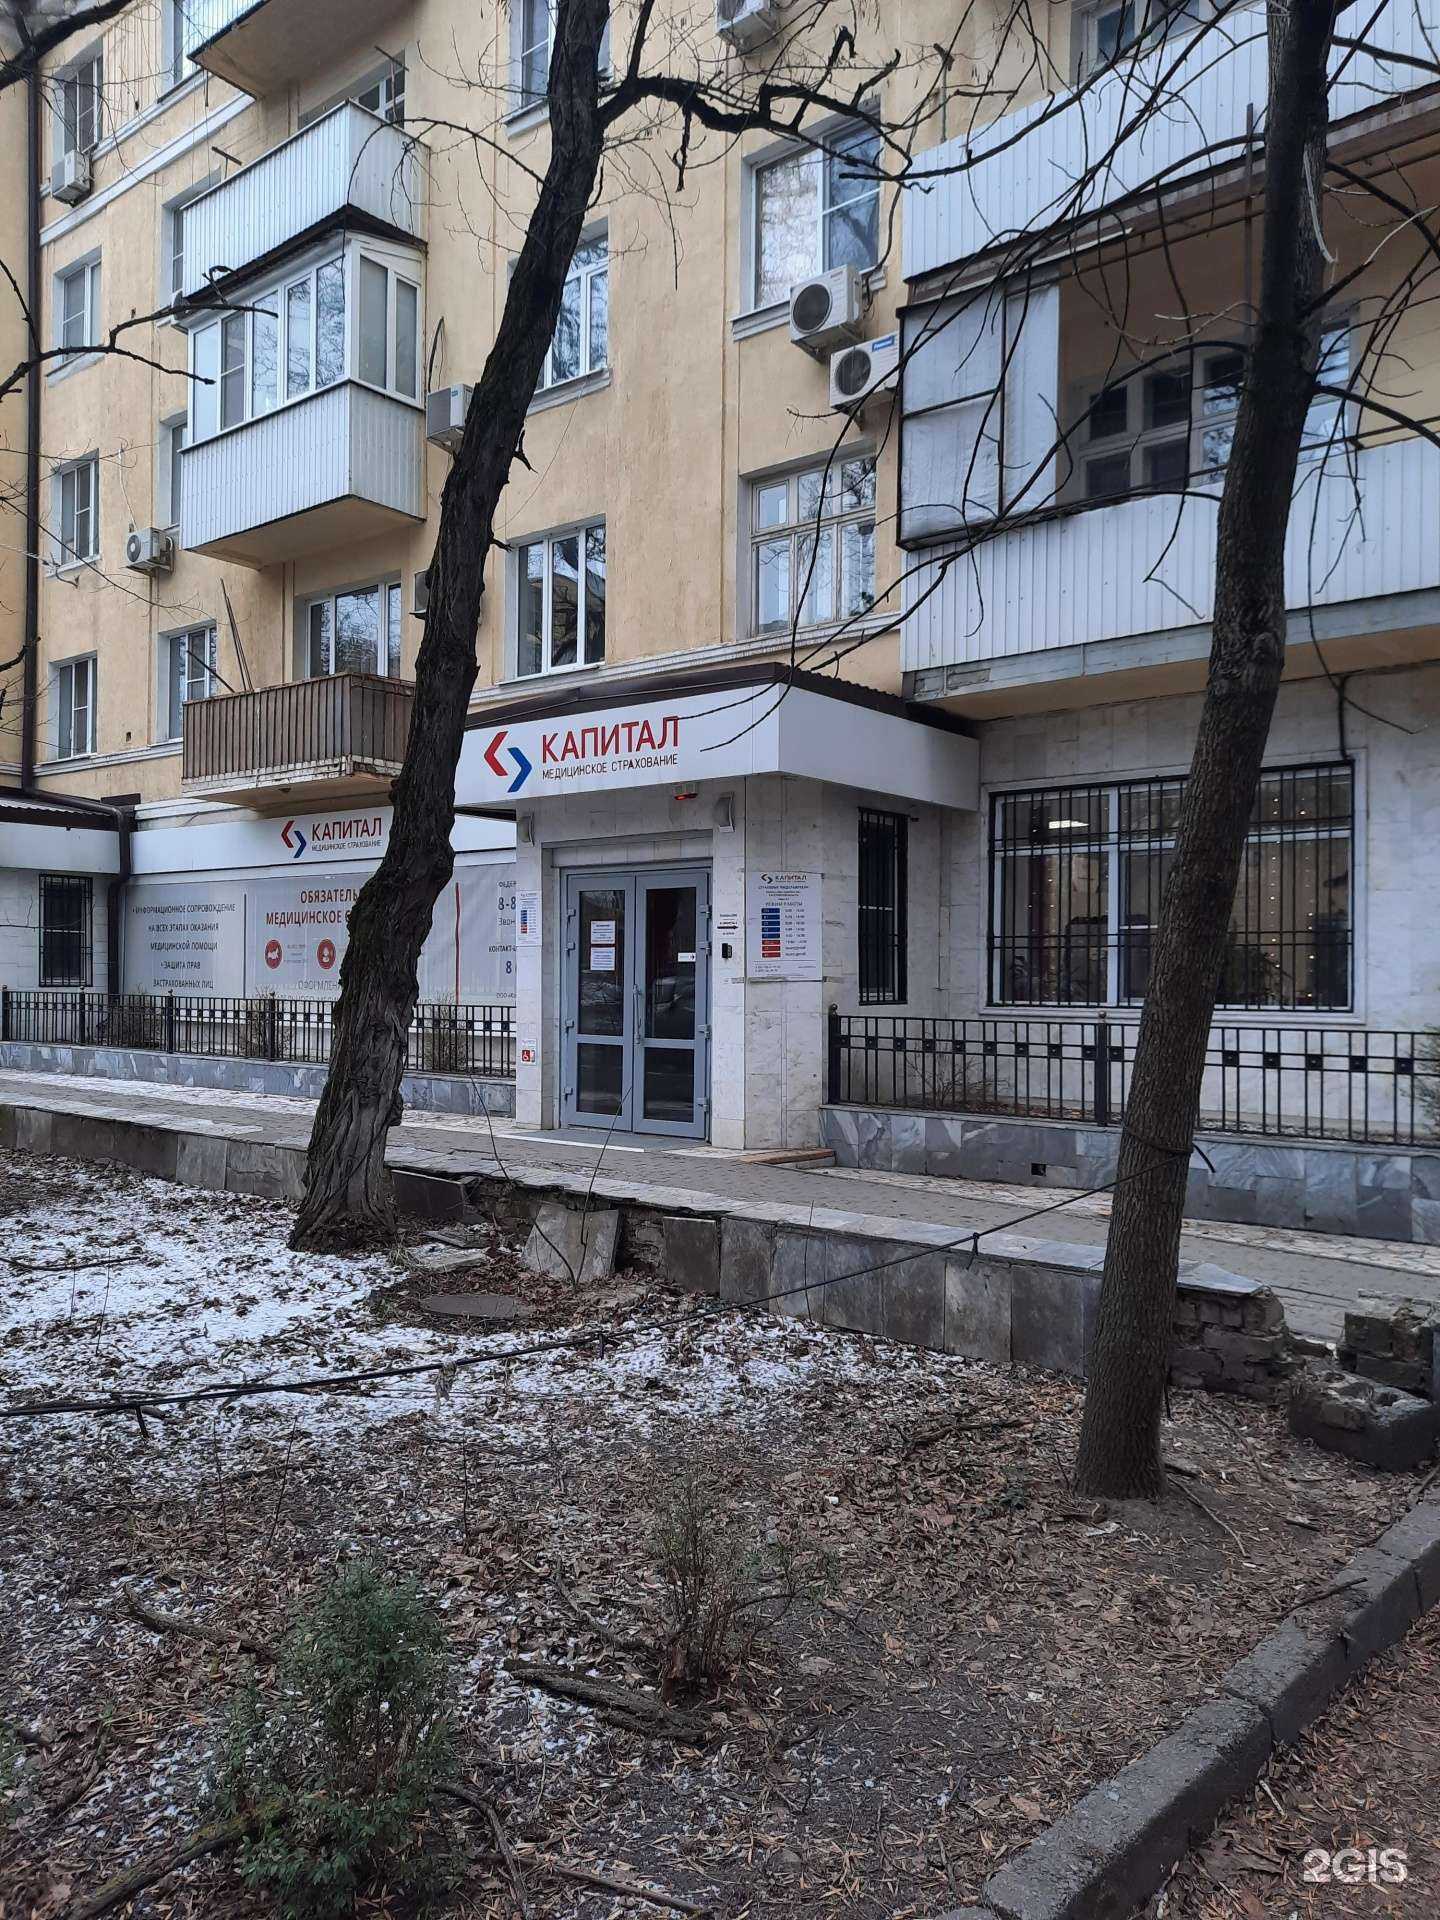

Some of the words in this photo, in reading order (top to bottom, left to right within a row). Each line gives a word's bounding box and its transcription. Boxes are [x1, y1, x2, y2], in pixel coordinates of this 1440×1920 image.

[542, 715, 680, 764] КАПИТАЛ
[542, 761, 607, 781] МЕДИЦИНСКОЕ
[611, 753, 678, 773] СТРАХОВАНИЕ
[311, 817, 382, 841] КАПИТАЛ
[311, 842, 347, 852] МЕДИЦИНСКОЕ
[347, 839, 383, 850] СТРАХОВАНИЕ
[135, 904, 186, 915] ИНФОРМАЦИОННОЕ
[187, 903, 236, 915] СОПРОВОЖДЕНИЕ
[266, 910, 342, 927] МЕДИЦИНСКОЕ
[190, 922, 219, 932] ОКАЗАНИЯ
[150, 940, 191, 952] МЕДИЦИНСКОЙ
[191, 942, 218, 952] ПОМОЩИ
[163, 961, 186, 970] ЗАЩИТА
[186, 961, 201, 969] ПРАВ
[505, 961, 512, 974] 8
[153, 979, 201, 989] ЗАСТРАХОВАННЫХ
[201, 980, 214, 990] ЛИЦ
